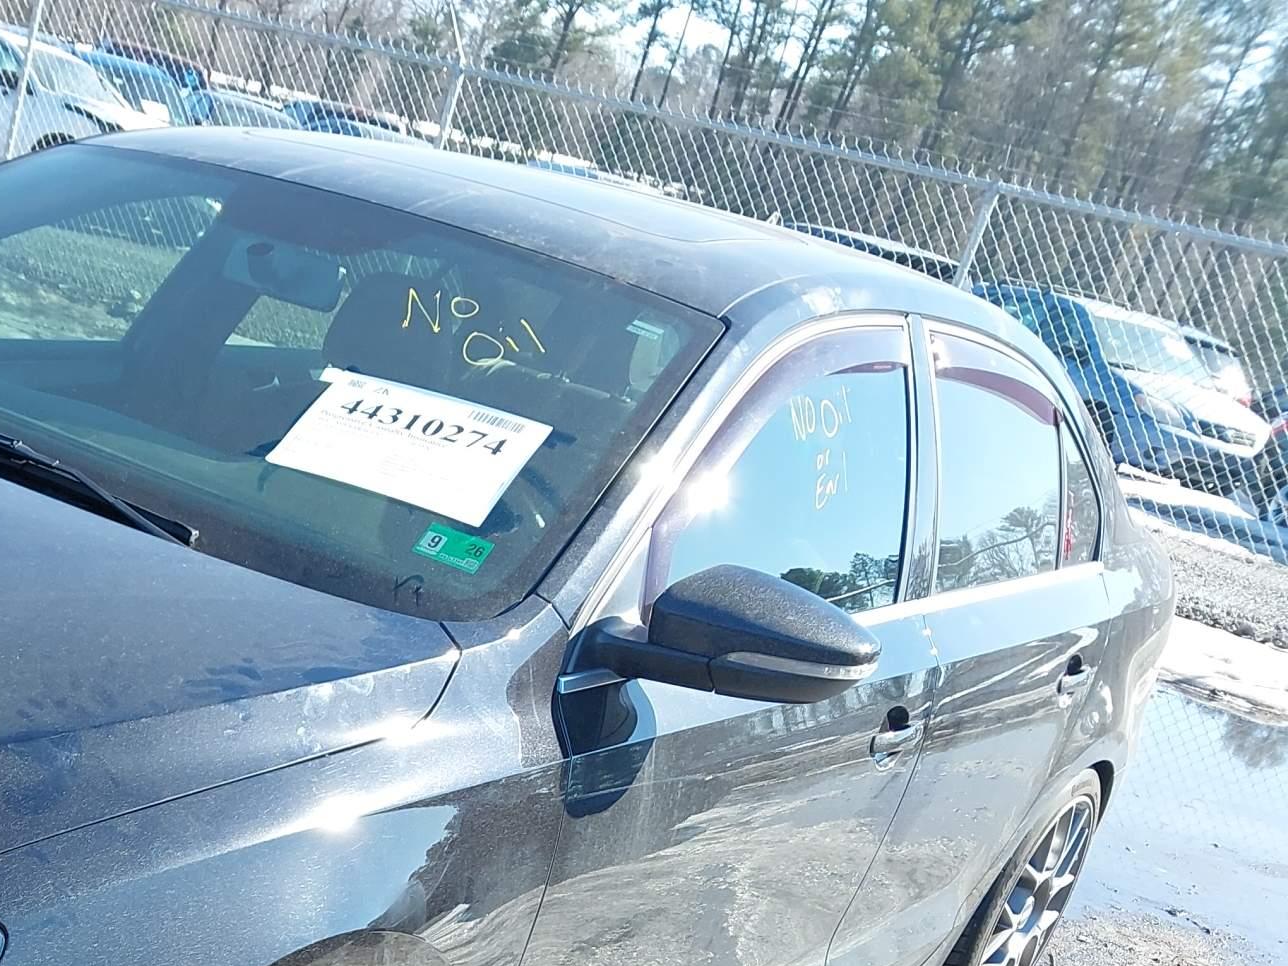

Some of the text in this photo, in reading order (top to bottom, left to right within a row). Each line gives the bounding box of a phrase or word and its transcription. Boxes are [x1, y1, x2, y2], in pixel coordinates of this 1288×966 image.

[340, 399, 508, 456] 44310274
[427, 535, 443, 548] 9
[465, 543, 486, 558] 26
